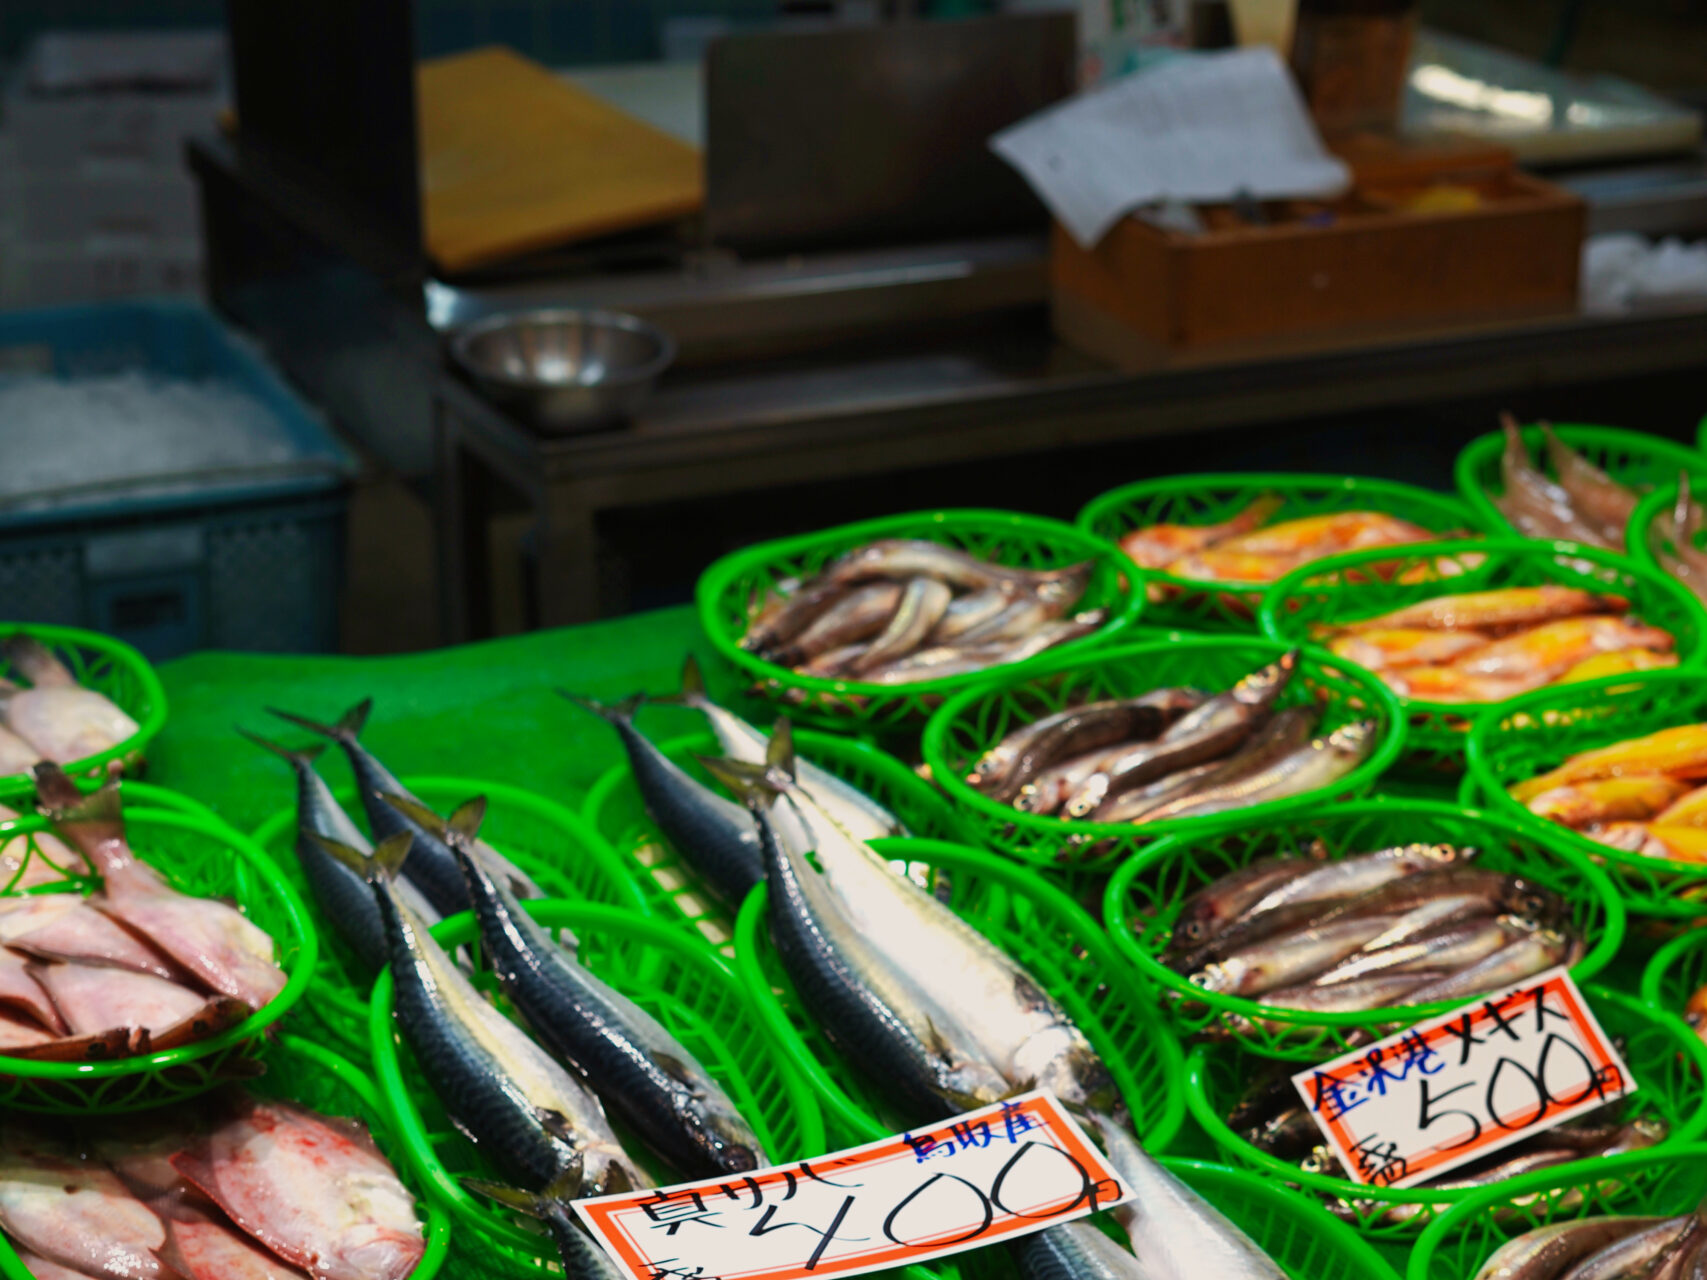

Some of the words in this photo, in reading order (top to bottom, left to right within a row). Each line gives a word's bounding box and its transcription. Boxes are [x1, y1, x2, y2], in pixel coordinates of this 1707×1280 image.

[1443, 985, 1569, 1066] メギス
[903, 1101, 1051, 1164] 鳥取産
